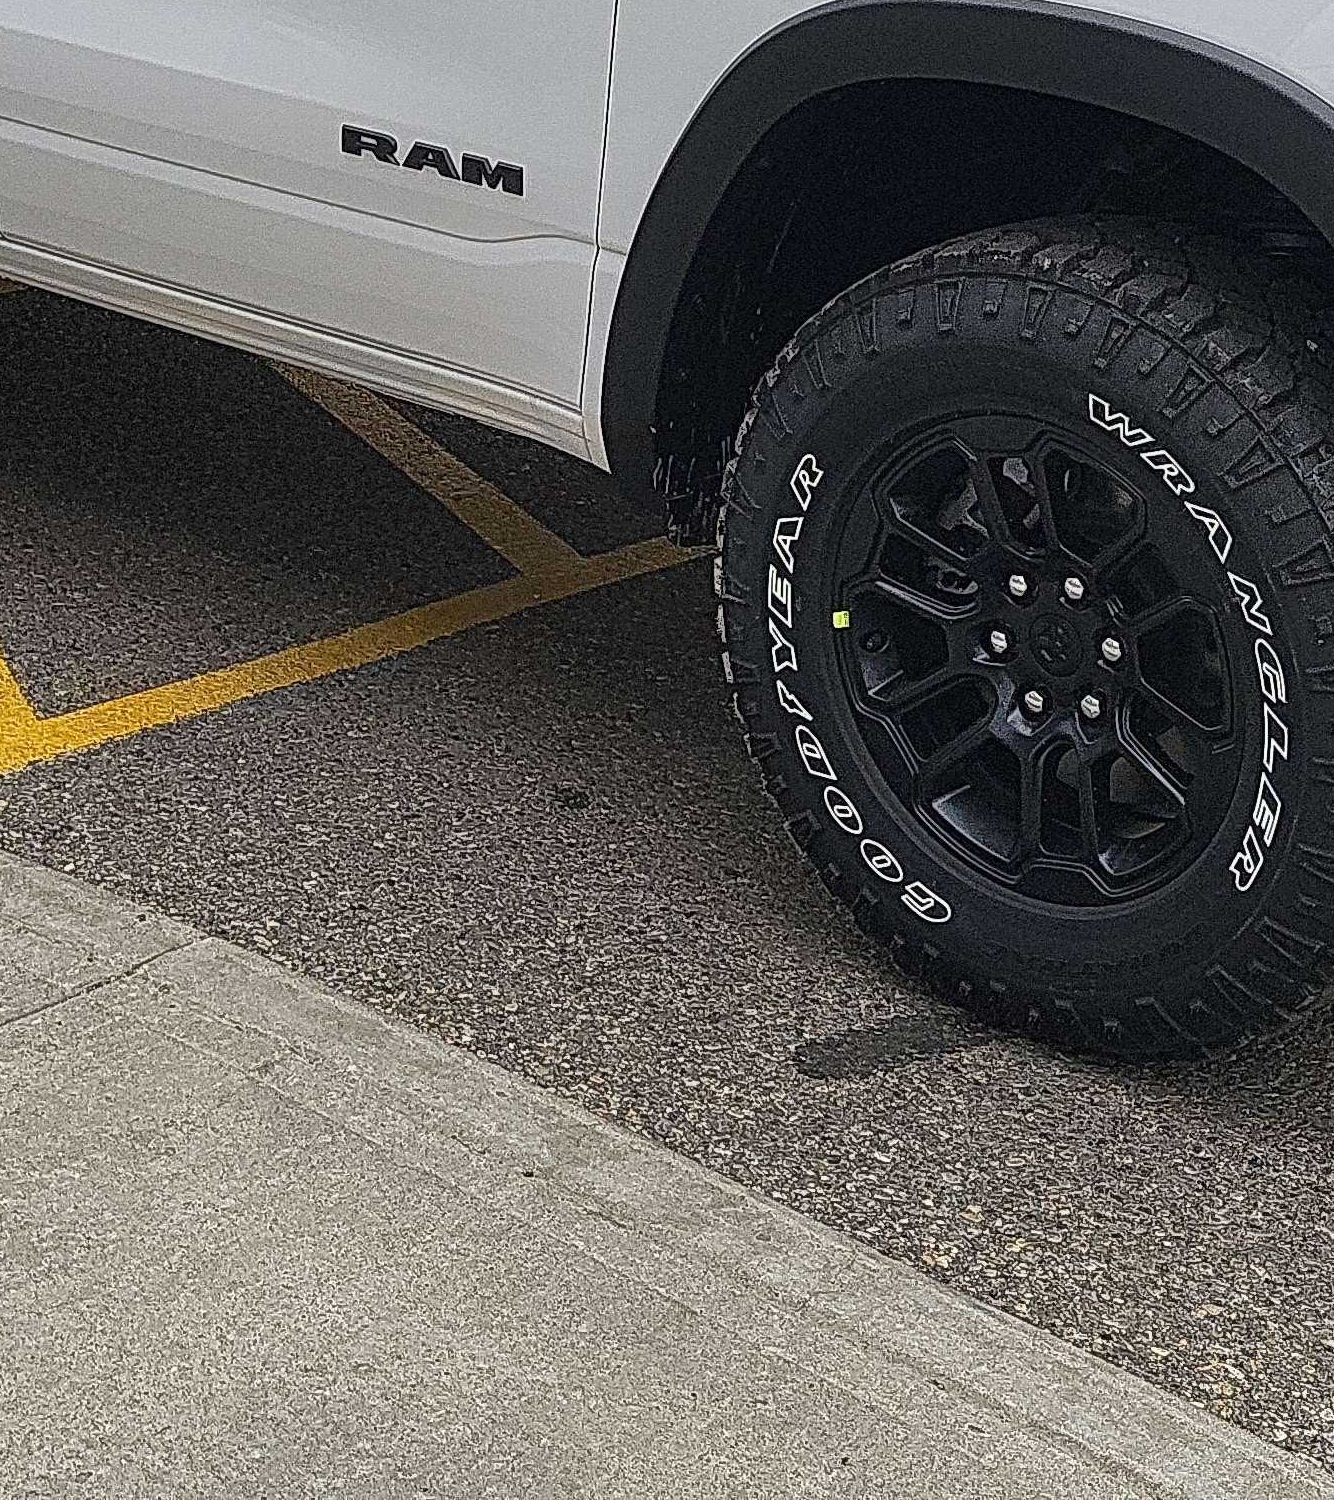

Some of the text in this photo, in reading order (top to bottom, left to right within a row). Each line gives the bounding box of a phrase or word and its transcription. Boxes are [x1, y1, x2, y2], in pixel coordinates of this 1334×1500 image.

[341, 124, 524, 197] RAM
[767, 454, 952, 923] GOODYEAR
[1088, 394, 1290, 892] WRANGLER
